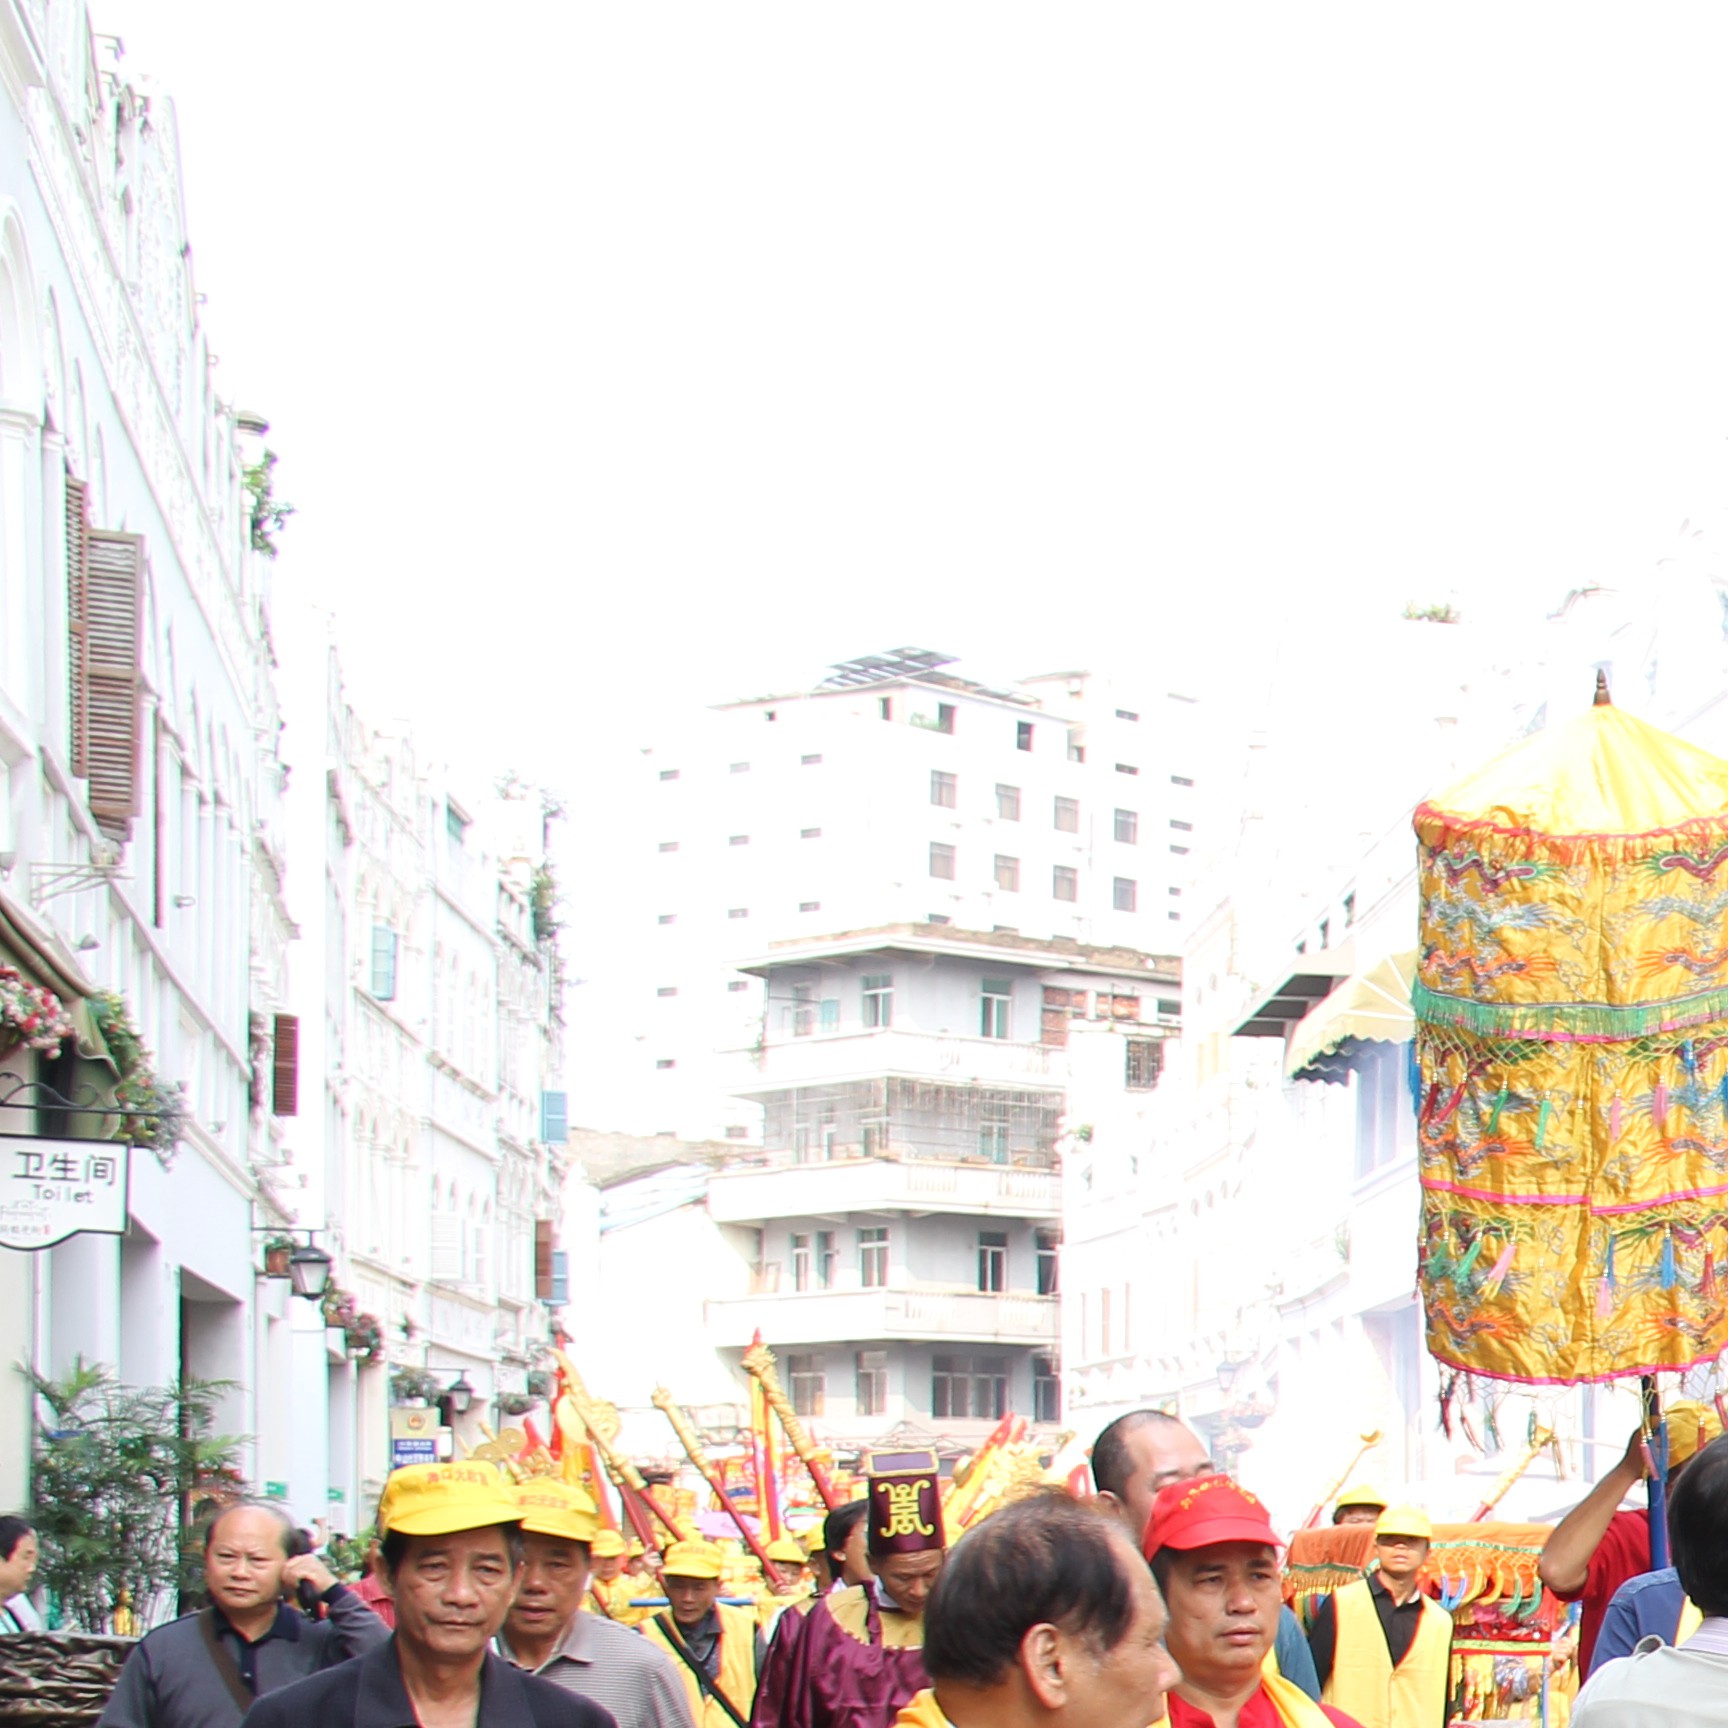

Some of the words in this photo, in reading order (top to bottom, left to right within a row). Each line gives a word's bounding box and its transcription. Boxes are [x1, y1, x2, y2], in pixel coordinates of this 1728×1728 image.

[12, 1150, 118, 1187] 卫生间
[32, 1183, 95, 1204] Toilet
